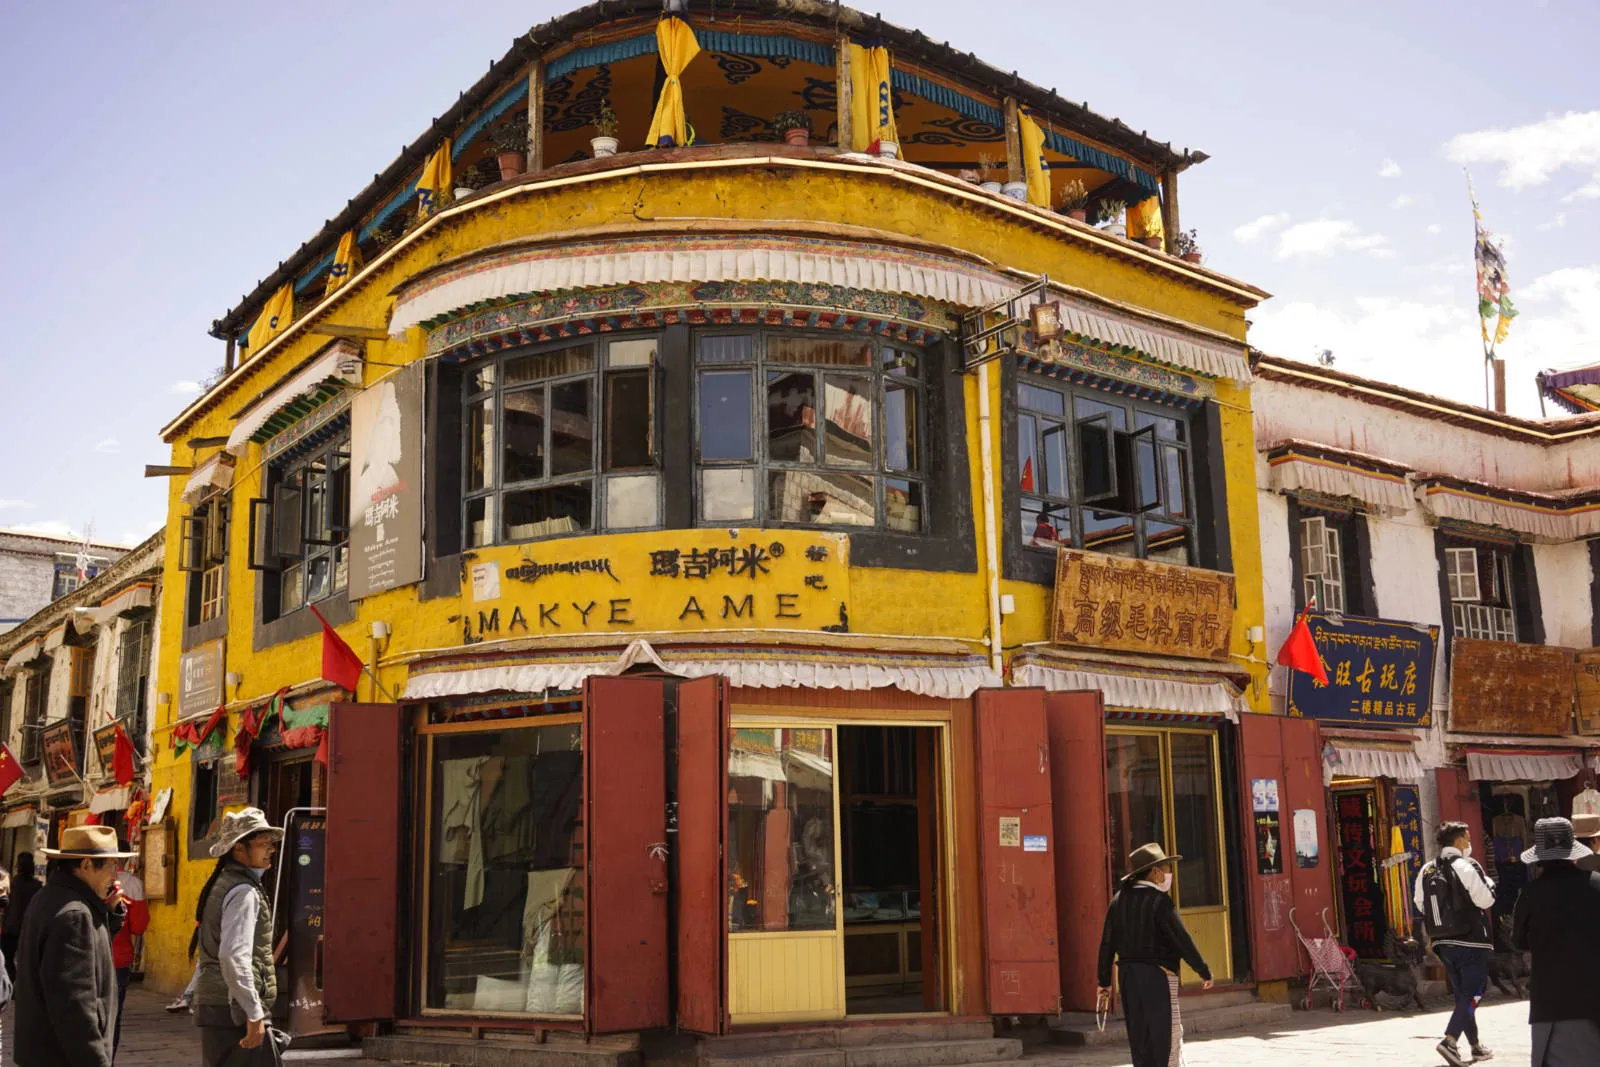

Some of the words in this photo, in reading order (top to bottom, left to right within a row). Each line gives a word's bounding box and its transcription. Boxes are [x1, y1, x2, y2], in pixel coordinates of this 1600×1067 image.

[478, 598, 633, 635] MAKYE
[679, 594, 802, 621] AME
[1350, 700, 1417, 717] 二楼精品古玩
